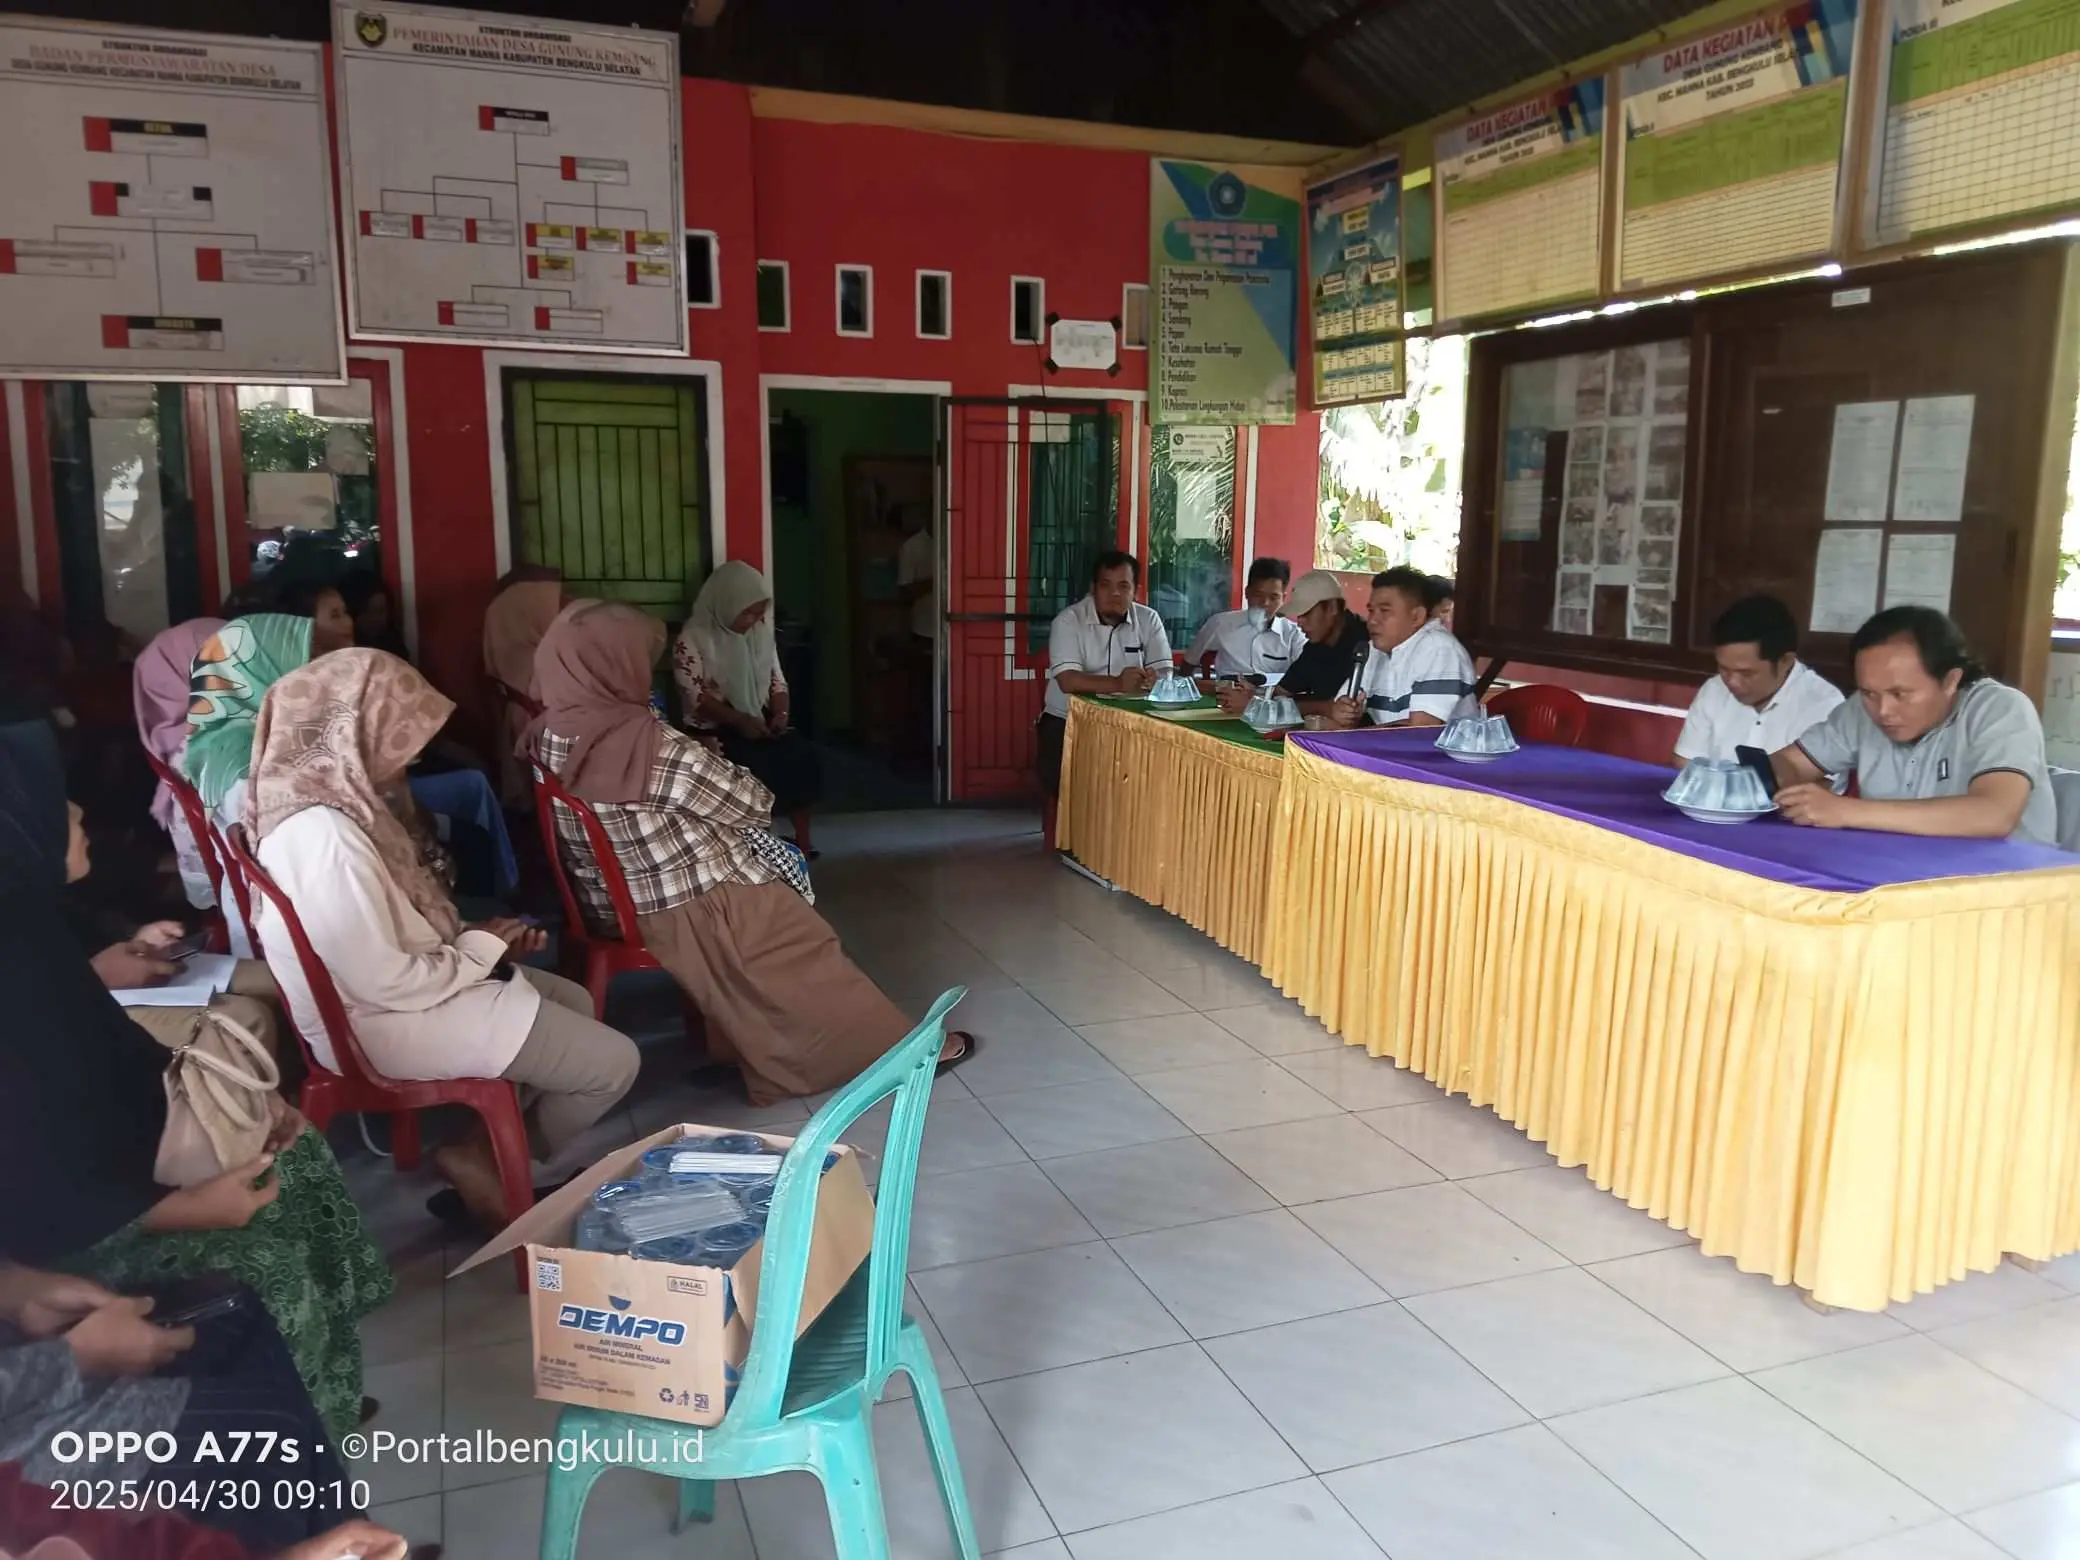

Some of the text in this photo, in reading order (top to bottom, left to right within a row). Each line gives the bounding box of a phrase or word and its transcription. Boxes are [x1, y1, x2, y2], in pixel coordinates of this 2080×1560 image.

[412, 43, 467, 56] KECAMATAN
[503, 38, 535, 53] DESA
[1663, 45, 1699, 73] DATA
[1702, 18, 1775, 58] KEGIATAN
[680, 1280, 703, 1289] HALAL
[558, 1304, 686, 1345] DEMPO
